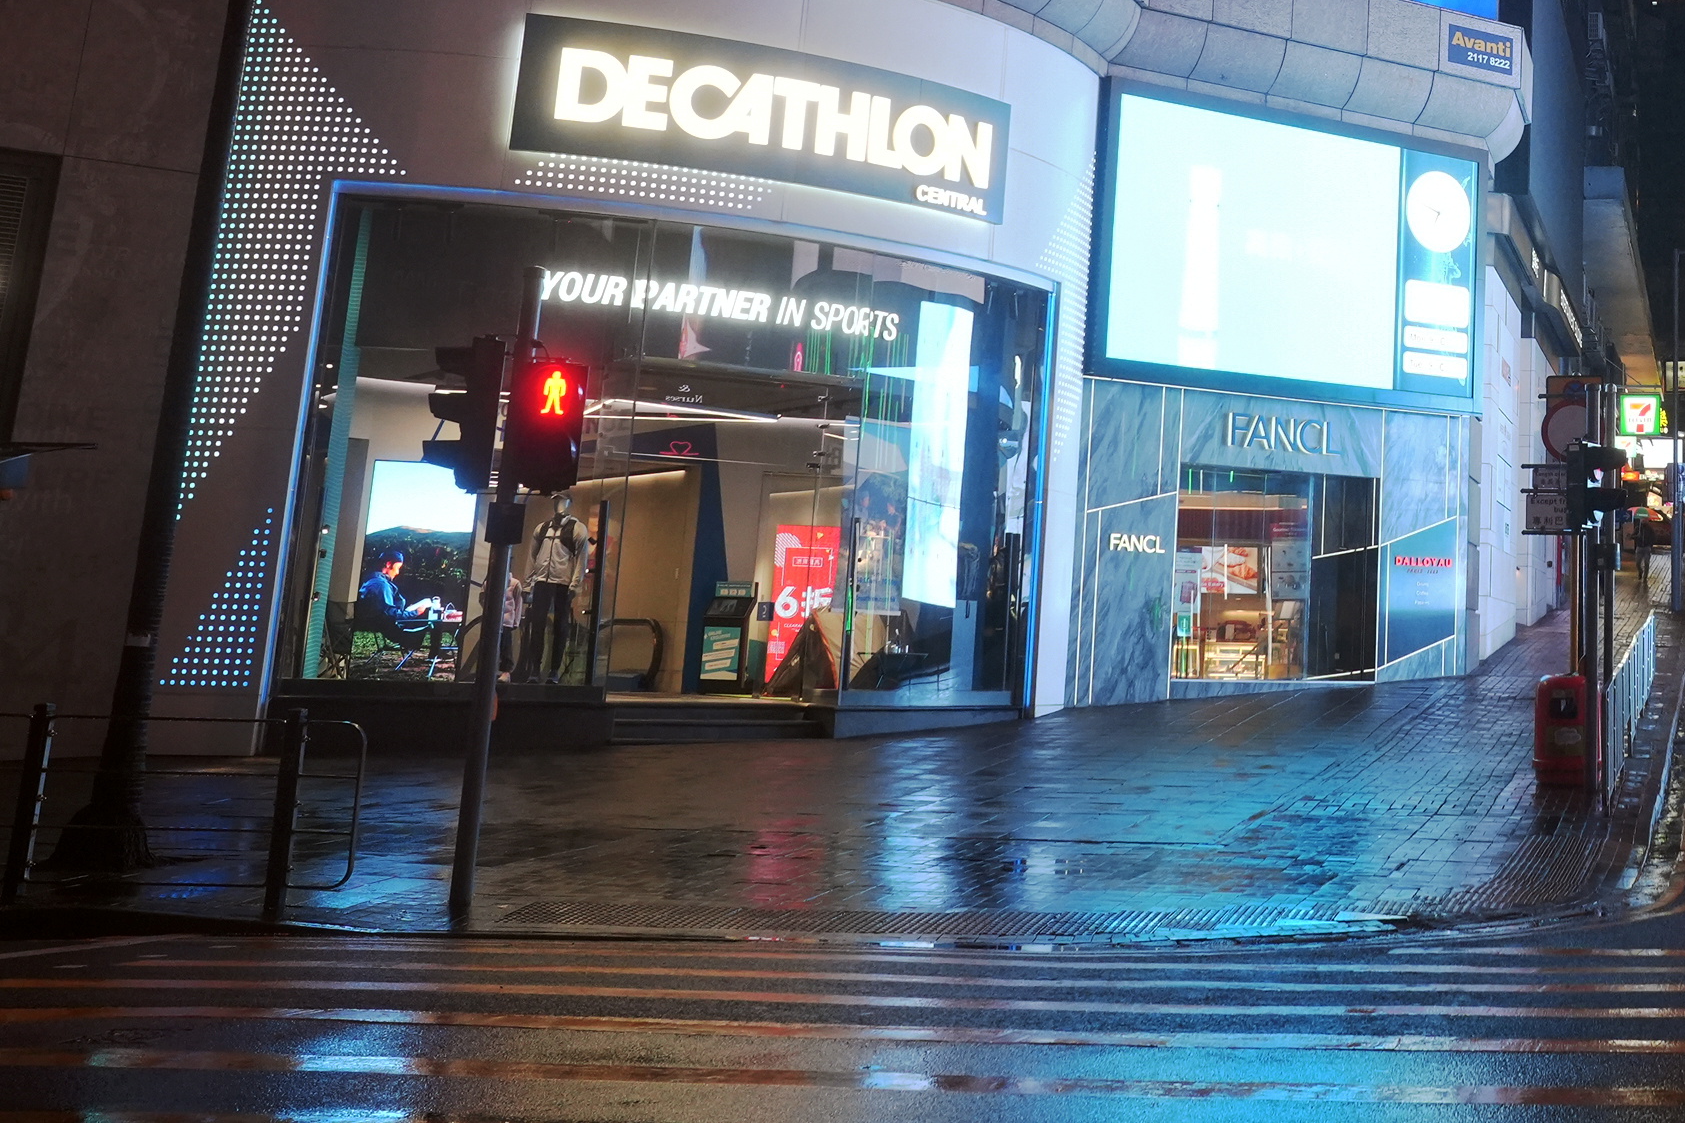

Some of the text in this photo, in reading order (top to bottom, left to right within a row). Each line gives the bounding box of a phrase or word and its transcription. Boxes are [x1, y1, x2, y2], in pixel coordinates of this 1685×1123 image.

[1451, 31, 1511, 57] Avanti
[1467, 51, 1510, 69] 2117 8222
[553, 46, 993, 190] DECATHLON
[916, 185, 987, 216] CENTRAL
[541, 271, 900, 341] YOUR PARTNER IN SPORTS
[1227, 411, 1342, 456] FANCL
[1530, 497, 1558, 506] Except
[1109, 532, 1166, 554] FANCL
[1394, 556, 1453, 568] DALLOYAU
